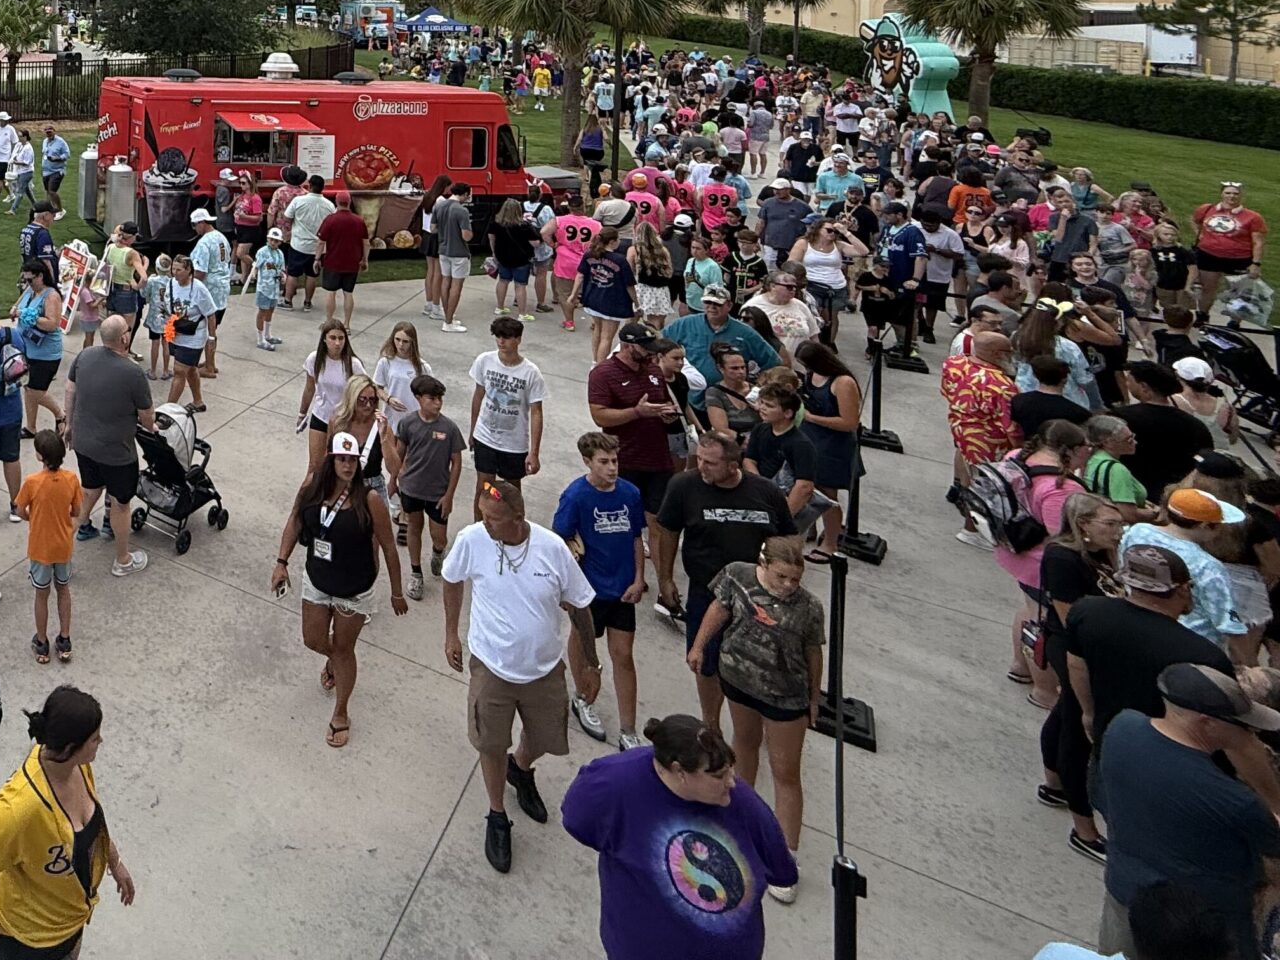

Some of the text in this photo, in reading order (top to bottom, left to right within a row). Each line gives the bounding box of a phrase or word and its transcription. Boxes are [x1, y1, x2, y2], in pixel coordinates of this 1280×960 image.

[378, 145, 401, 167] PIZZA
[707, 193, 731, 208] 99
[565, 225, 592, 243] 99
[486, 370, 527, 386] DRIVE THE
[486, 375, 526, 390] AMERICAN
